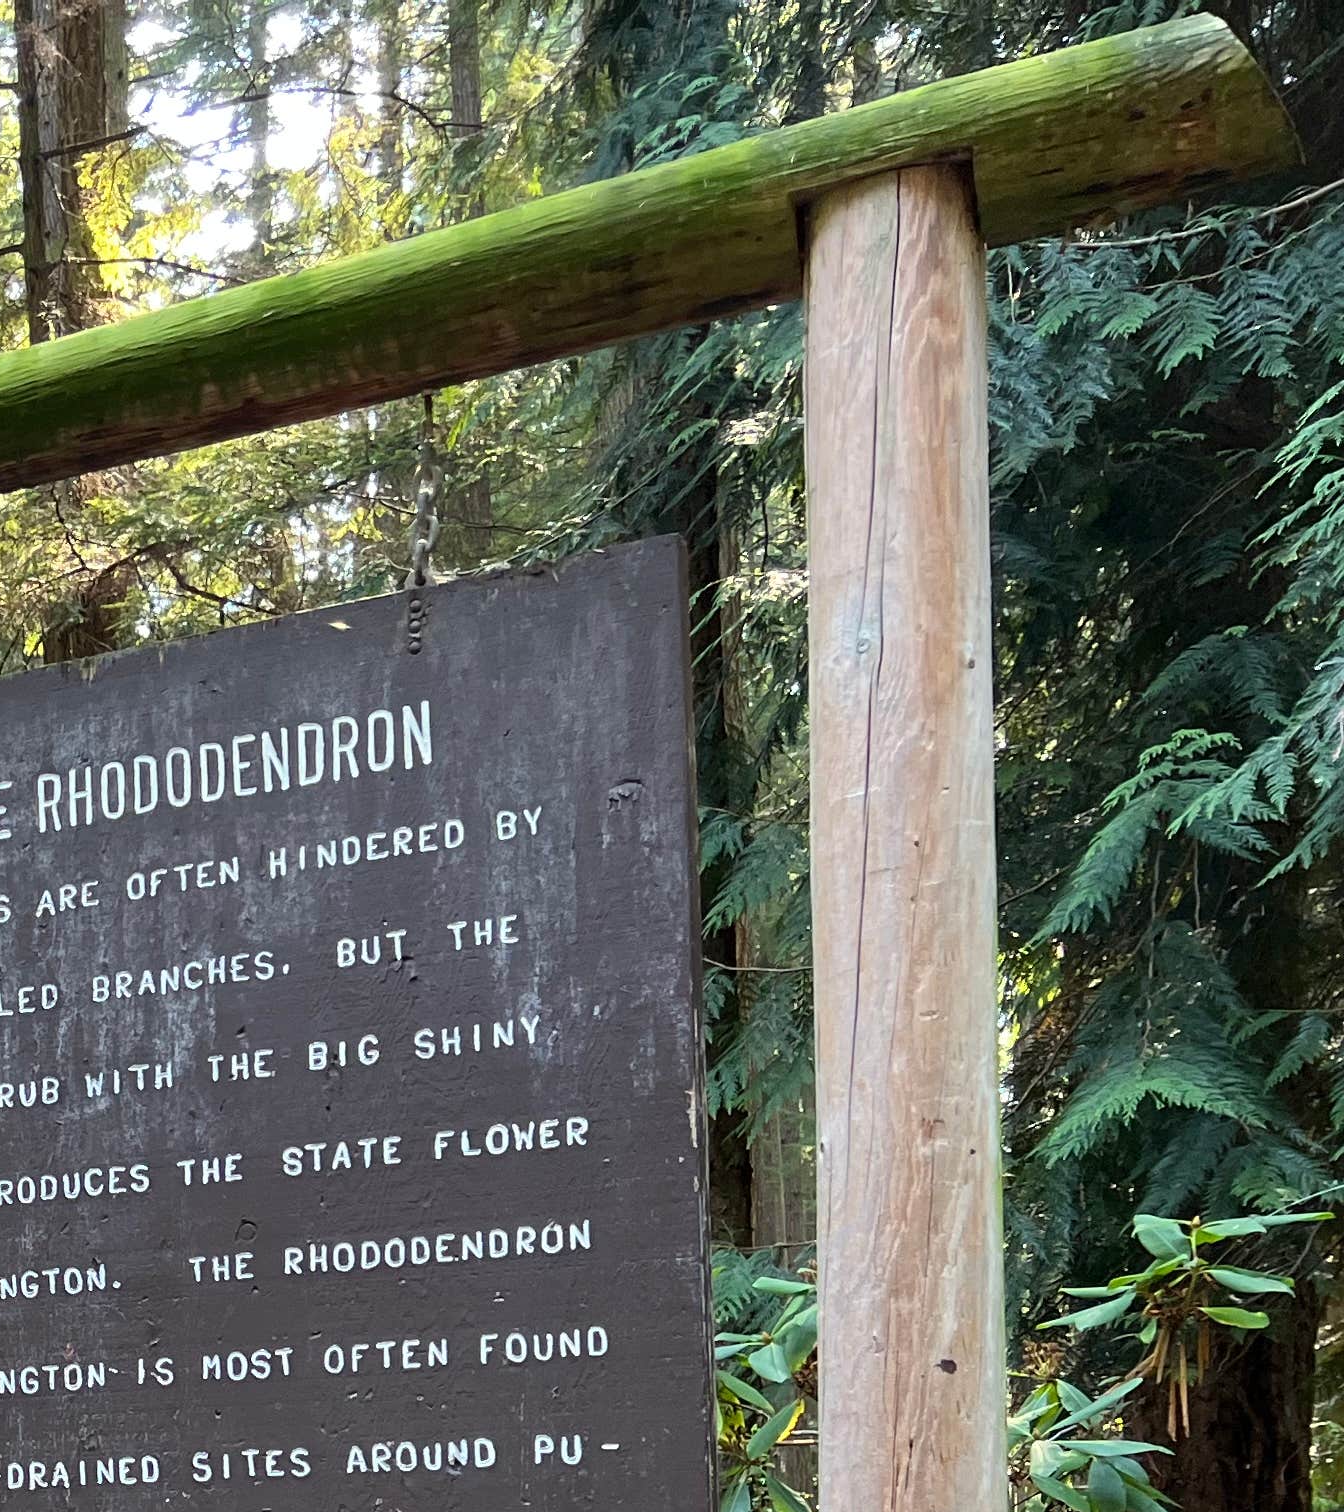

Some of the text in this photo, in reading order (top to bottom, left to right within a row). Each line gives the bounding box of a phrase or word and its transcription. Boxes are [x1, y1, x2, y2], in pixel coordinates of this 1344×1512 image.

[37, 700, 436, 834] RHODODENDRON
[35, 880, 100, 918] ARE
[126, 856, 239, 900] OFTEN
[269, 818, 465, 880] HINDERED
[496, 805, 542, 841] BY
[336, 928, 407, 968] BUT
[446, 914, 520, 951] THE
[84, 1060, 173, 1098] WITH
[207, 1049, 274, 1082] THE
[308, 1034, 380, 1071] BIG
[414, 1014, 540, 1060] SHINY
[176, 1153, 243, 1186] THE
[282, 1135, 402, 1177] STATE
[434, 1116, 589, 1160] FLOWER
[188, 1251, 254, 1283] THE
[284, 1219, 591, 1275] RHODODENDRON
[137, 1357, 174, 1386] IS
[202, 1347, 294, 1381] MOST
[323, 1338, 448, 1374] OFTEN
[480, 1326, 608, 1365] FOUND
[192, 1447, 311, 1482] SITES
[346, 1437, 496, 1474] AROUND
